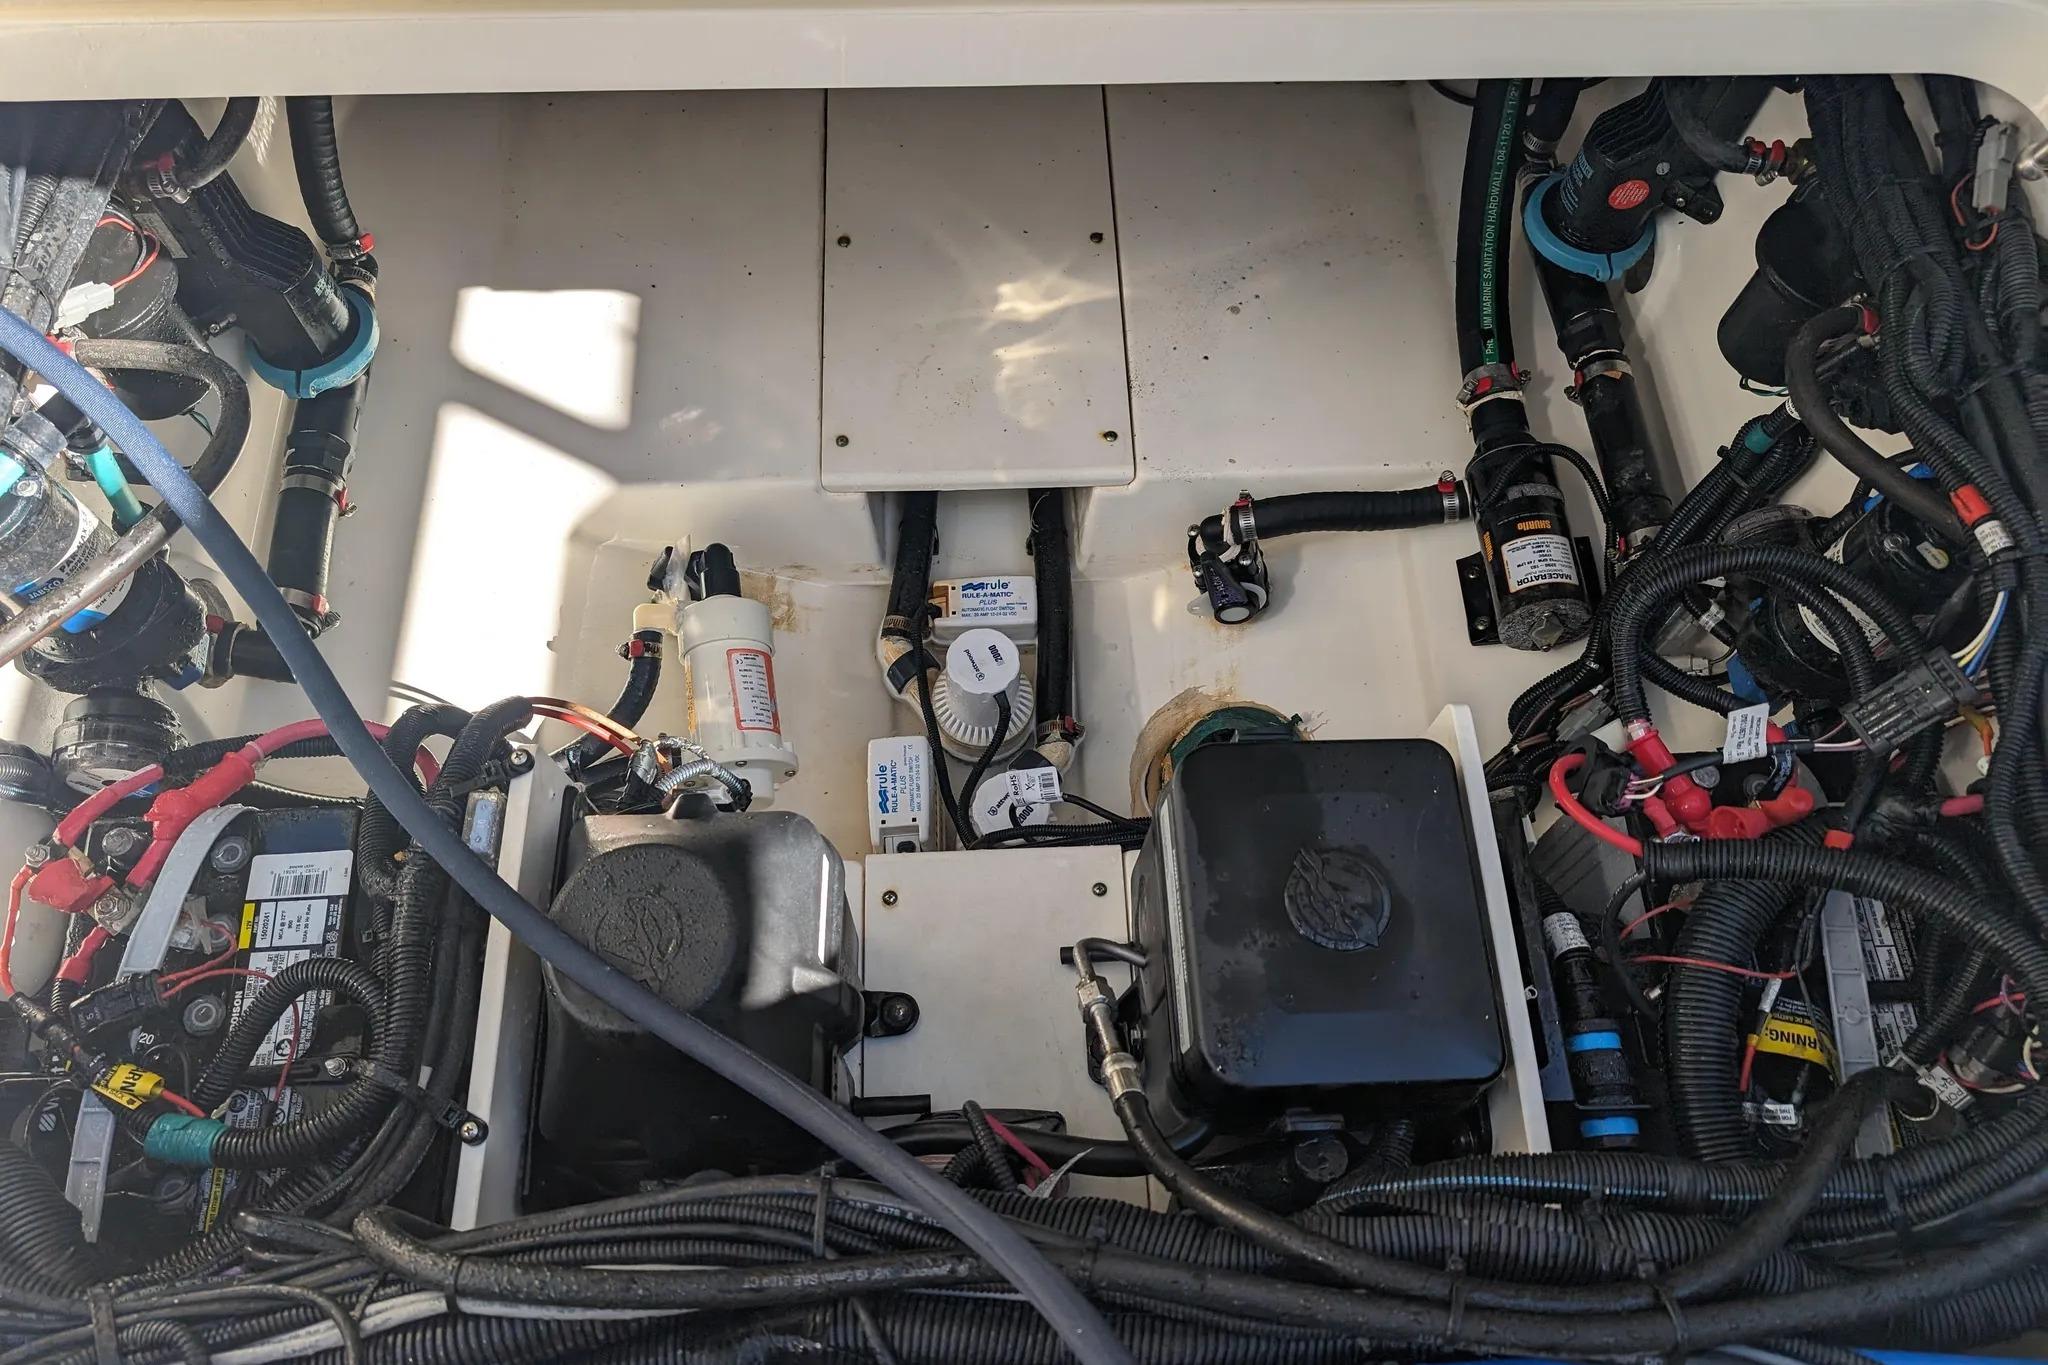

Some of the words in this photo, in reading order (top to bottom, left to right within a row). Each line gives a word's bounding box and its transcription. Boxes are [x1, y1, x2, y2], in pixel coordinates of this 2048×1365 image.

[1497, 124, 1512, 165] 104-1120
[1488, 169, 1504, 222] HARDWALL
[1483, 225, 1495, 278] SANITATION
[1483, 282, 1492, 314] MARINE
[28, 580, 61, 600] JABSCO
[986, 579, 1009, 590] rule
[1517, 572, 1572, 586] MACERATOR
[988, 644, 1003, 662] 2000
[875, 765, 887, 789] rule
[1010, 775, 1019, 795] RoHS
[261, 912, 270, 940] 15020241
[793, 1273, 818, 1287] SAE
